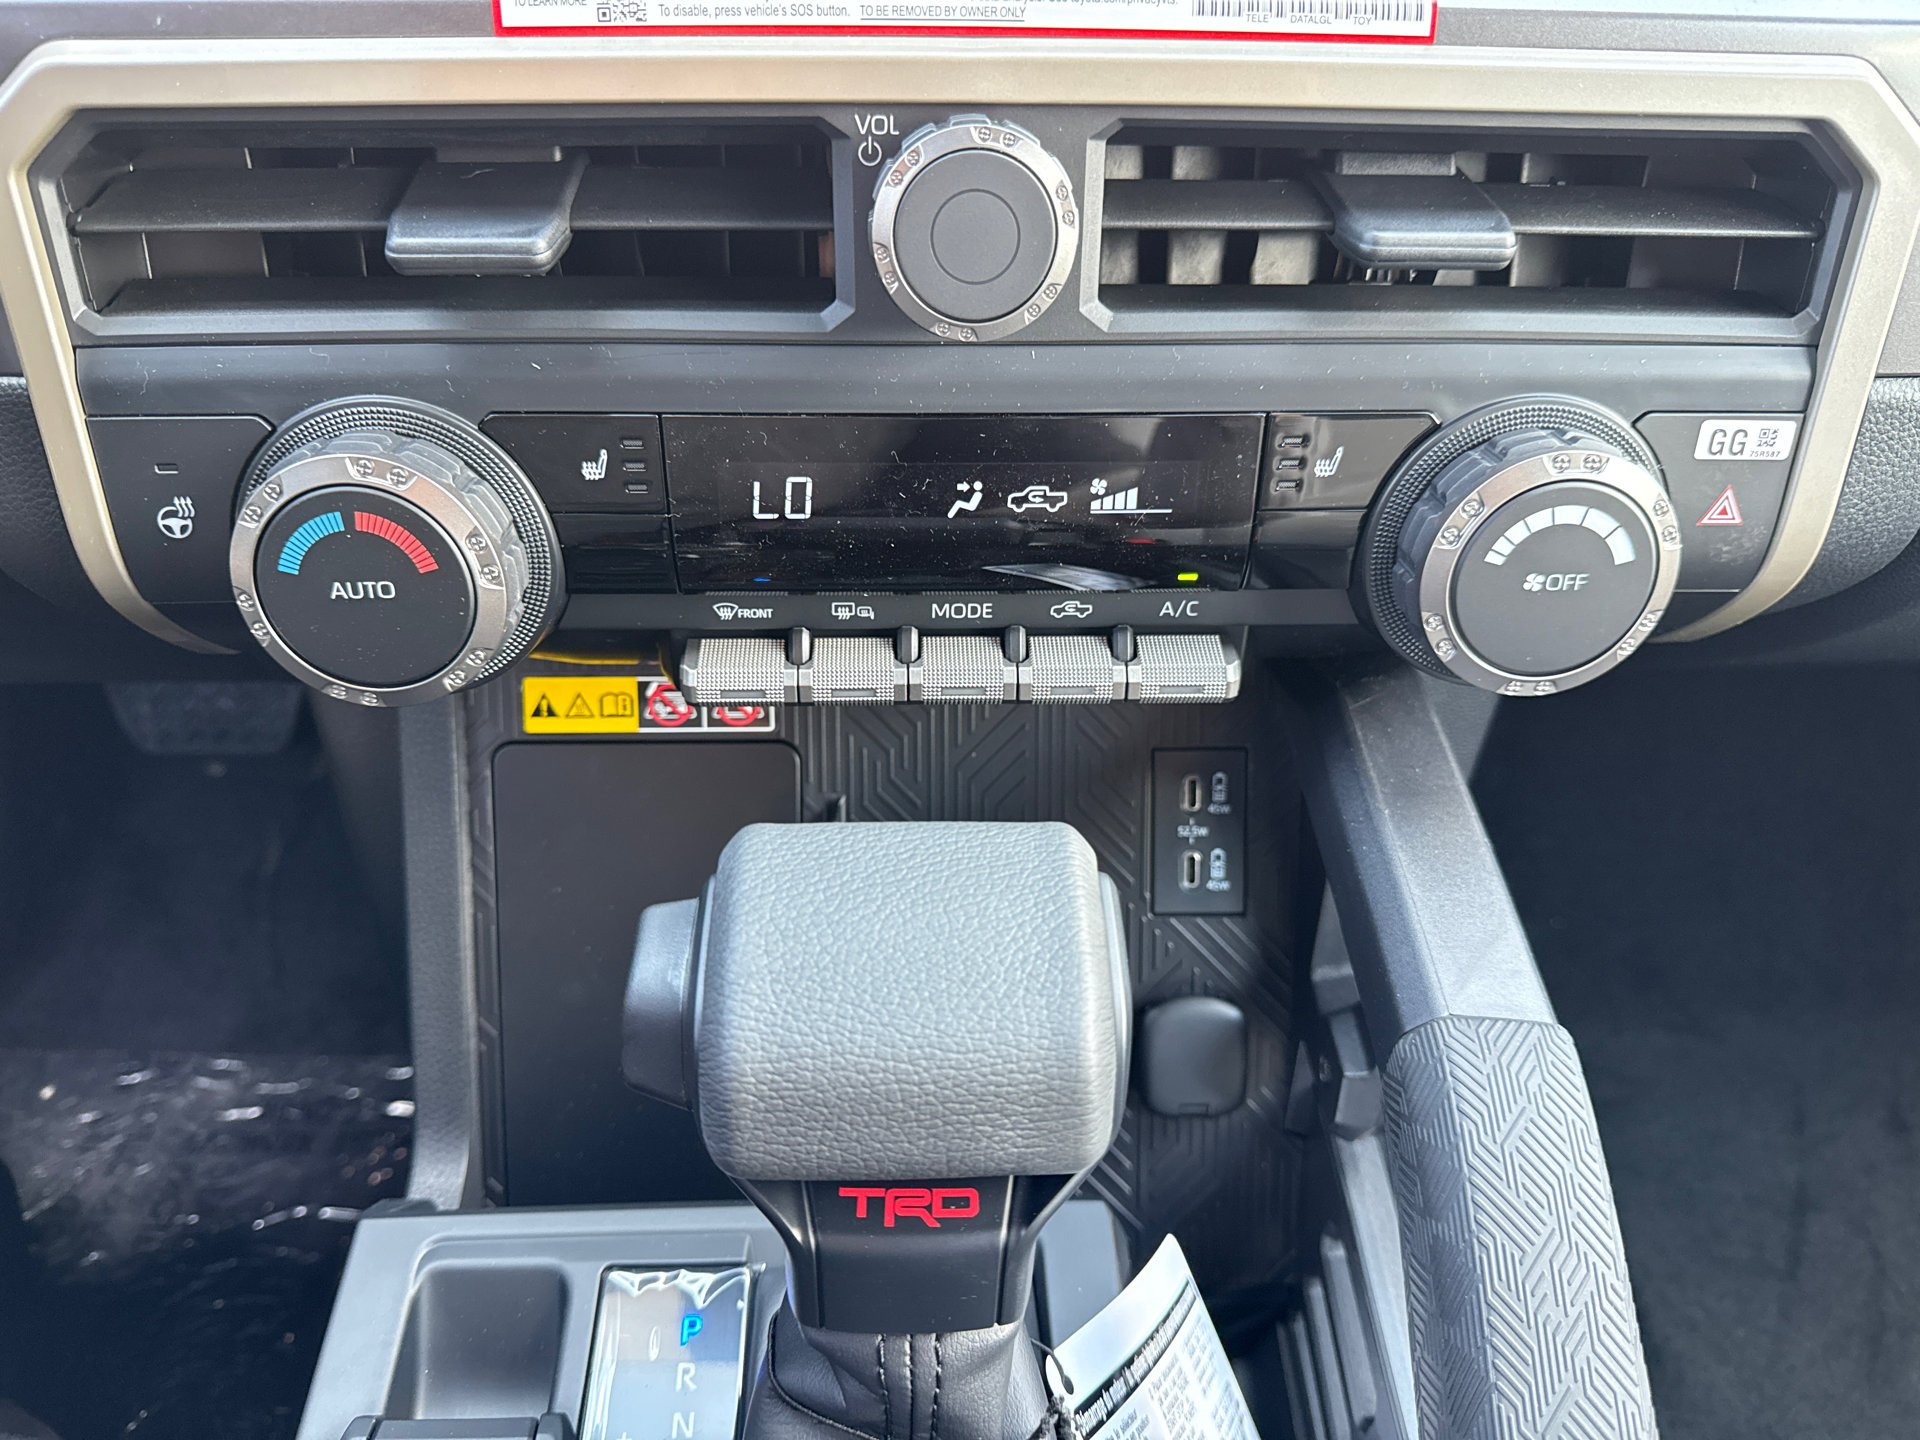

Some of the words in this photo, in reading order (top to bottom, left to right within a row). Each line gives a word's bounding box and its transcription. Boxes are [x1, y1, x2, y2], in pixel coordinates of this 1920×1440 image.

[658, 4, 671, 17] To
[673, 4, 712, 18] disable,
[715, 6, 742, 20] press
[745, 4, 787, 17] vehicle's
[790, 4, 813, 17] SOS
[816, 4, 851, 17] button.
[860, 5, 874, 17] TO
[876, 5, 889, 17] BE
[892, 5, 942, 17] REMOVED
[944, 6, 958, 17] BY
[960, 6, 998, 17] OWNER
[1000, 6, 1026, 18] ONLY
[1246, 14, 1269, 23] TELE
[1290, 14, 1332, 25] DATALGL
[1353, 16, 1373, 26] TOY
[854, 113, 900, 136] VOL
[1707, 428, 1749, 456] GG
[330, 580, 396, 600] AUTO
[1545, 572, 1590, 591] OFF
[737, 604, 774, 619] FRONT
[931, 602, 993, 619] MODE
[1159, 599, 1200, 618] A/C
[838, 1187, 980, 1228] TRD
[679, 1313, 703, 1347] P
[675, 1362, 697, 1393] R
[671, 1411, 695, 1439] N
